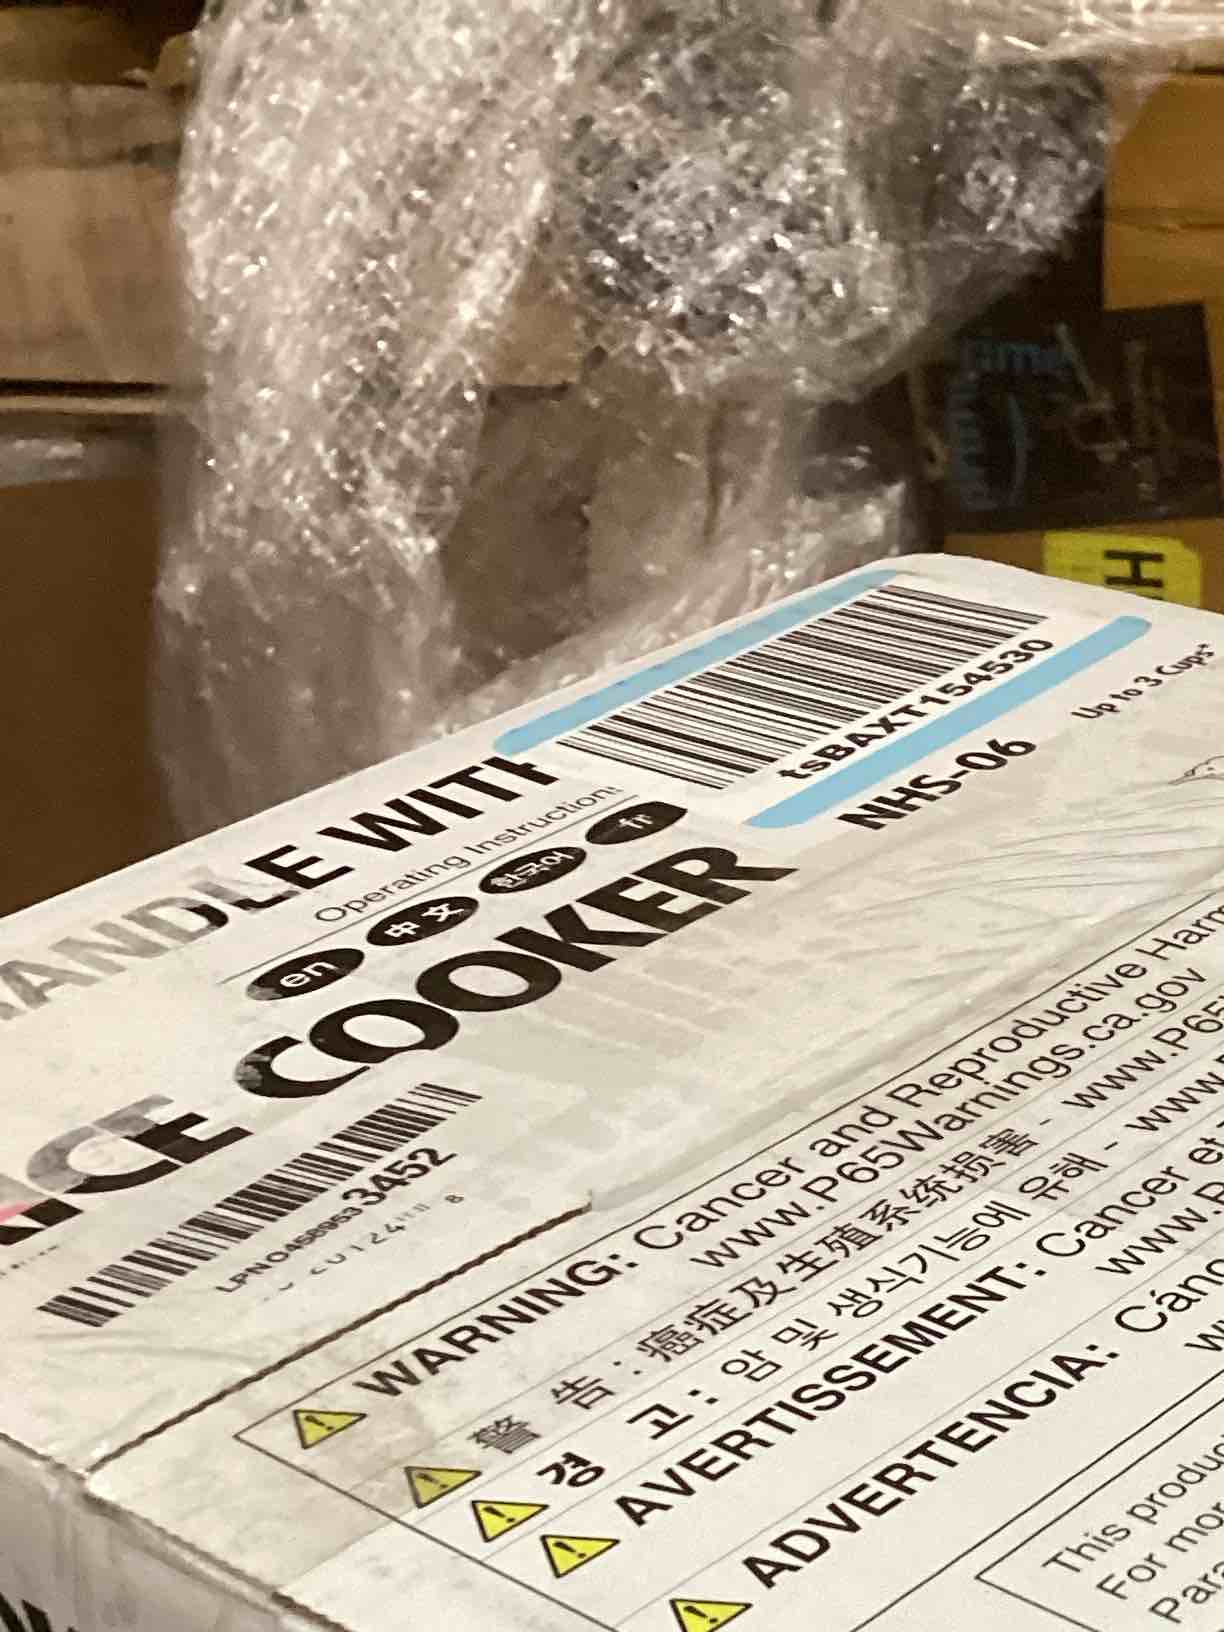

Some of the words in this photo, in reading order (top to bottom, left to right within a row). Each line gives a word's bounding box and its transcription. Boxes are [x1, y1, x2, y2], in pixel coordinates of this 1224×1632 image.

[778, 639, 1054, 781] tsBAXT154530
[1072, 702, 1119, 719] Up
[1109, 687, 1143, 701] to
[1134, 676, 1162, 688] 3
[619, 810, 656, 831] fr
[836, 737, 1038, 831] NHS-06
[0, 844, 355, 1020] ANDLE
[314, 853, 472, 924] Operating
[384, 901, 467, 941] 中文
[231, 846, 798, 1099] COOKER
[279, 960, 338, 987] en
[690, 967, 1207, 1267] www.P65Warnings.ca.gov
[352, 1241, 639, 1396] WARNING:
[633, 1156, 805, 1249] Cancer
[809, 1104, 899, 1157] and
[886, 962, 1148, 1107] Reproductive
[721, 1349, 783, 1382] 암
[771, 1317, 839, 1351] 및
[827, 1200, 1032, 1318] 생식기능에
[1018, 1152, 1109, 1200] 유해
[614, 1261, 1047, 1527] AVERTISSEMENT:
[1036, 1165, 1190, 1257] Cancer
[742, 1343, 1120, 1589] ADVERTENCIA:
[1041, 1523, 1131, 1572] This
[1096, 1552, 1168, 1600] For
